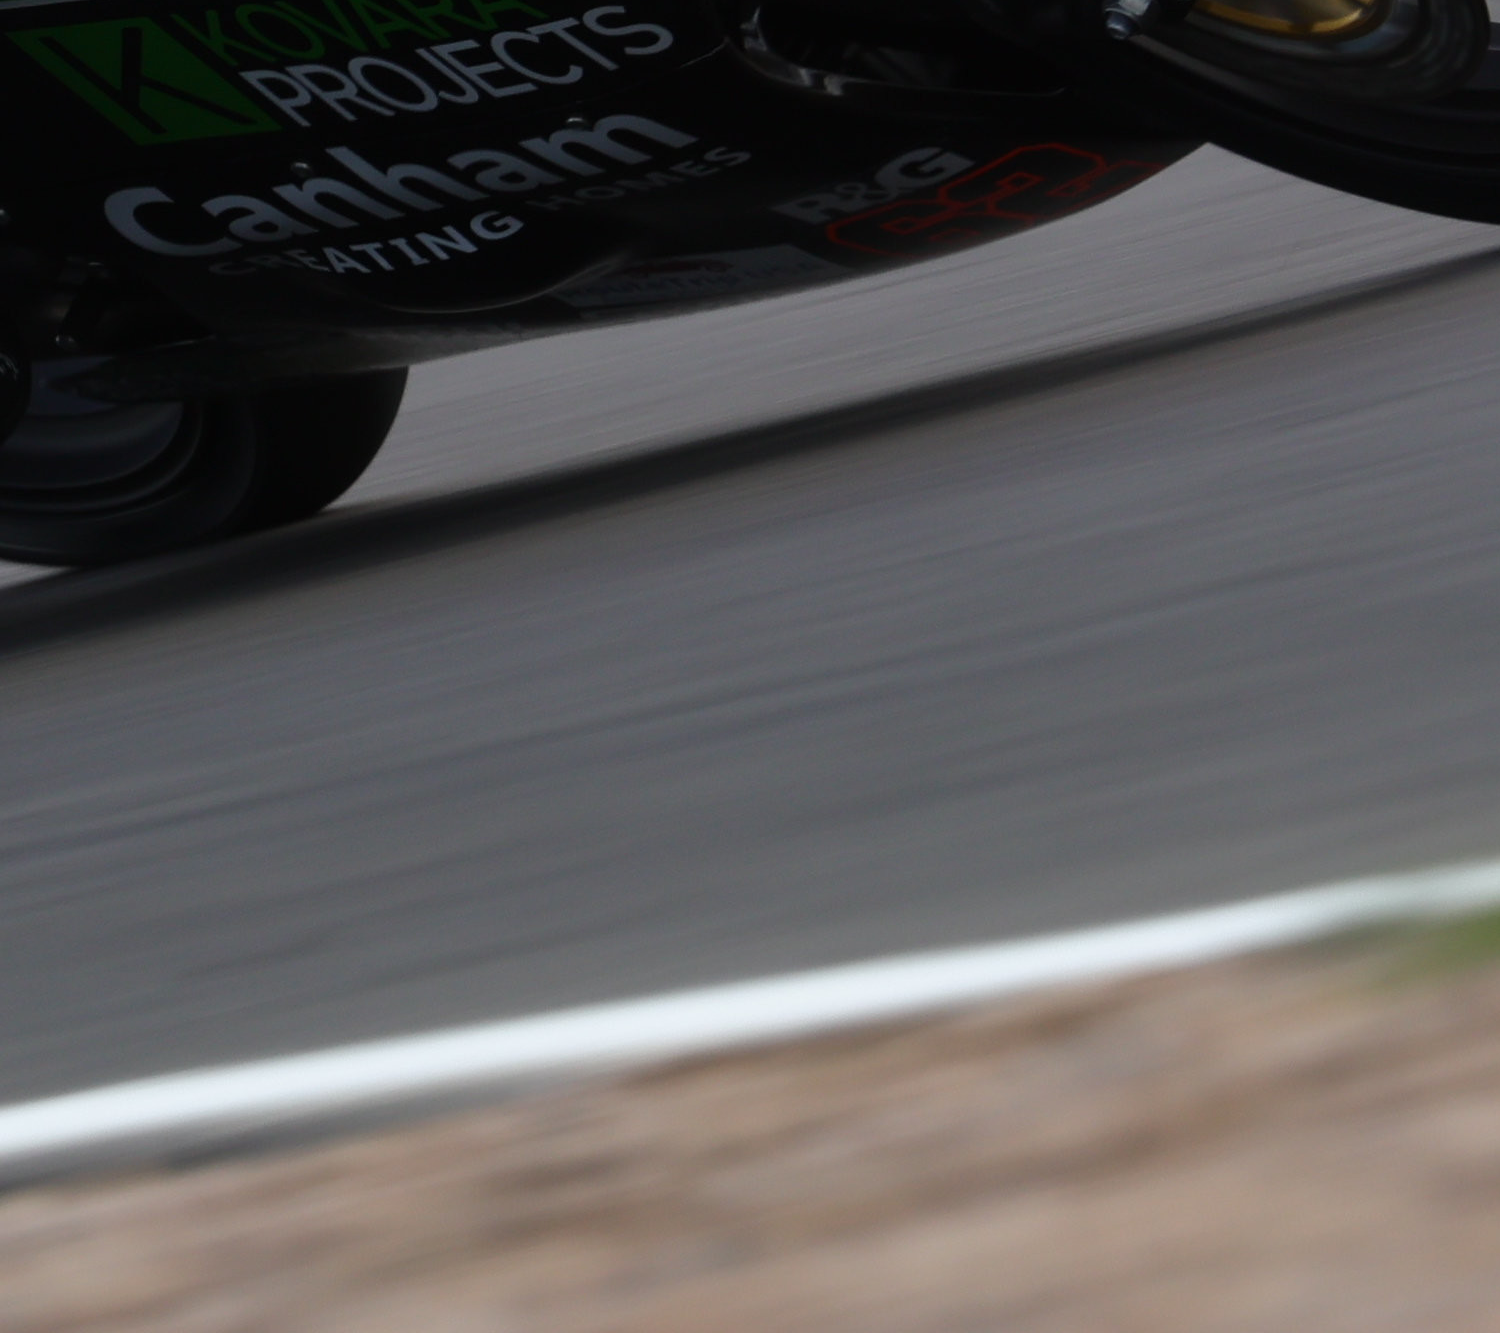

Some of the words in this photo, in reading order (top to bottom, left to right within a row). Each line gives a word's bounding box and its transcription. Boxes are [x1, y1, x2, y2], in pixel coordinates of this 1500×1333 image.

[240, 6, 674, 127] PROJECTS
[105, 113, 699, 257] Canham
[209, 209, 525, 277] CREATING
[530, 145, 752, 213] HOMES
[771, 146, 978, 224] R&G
